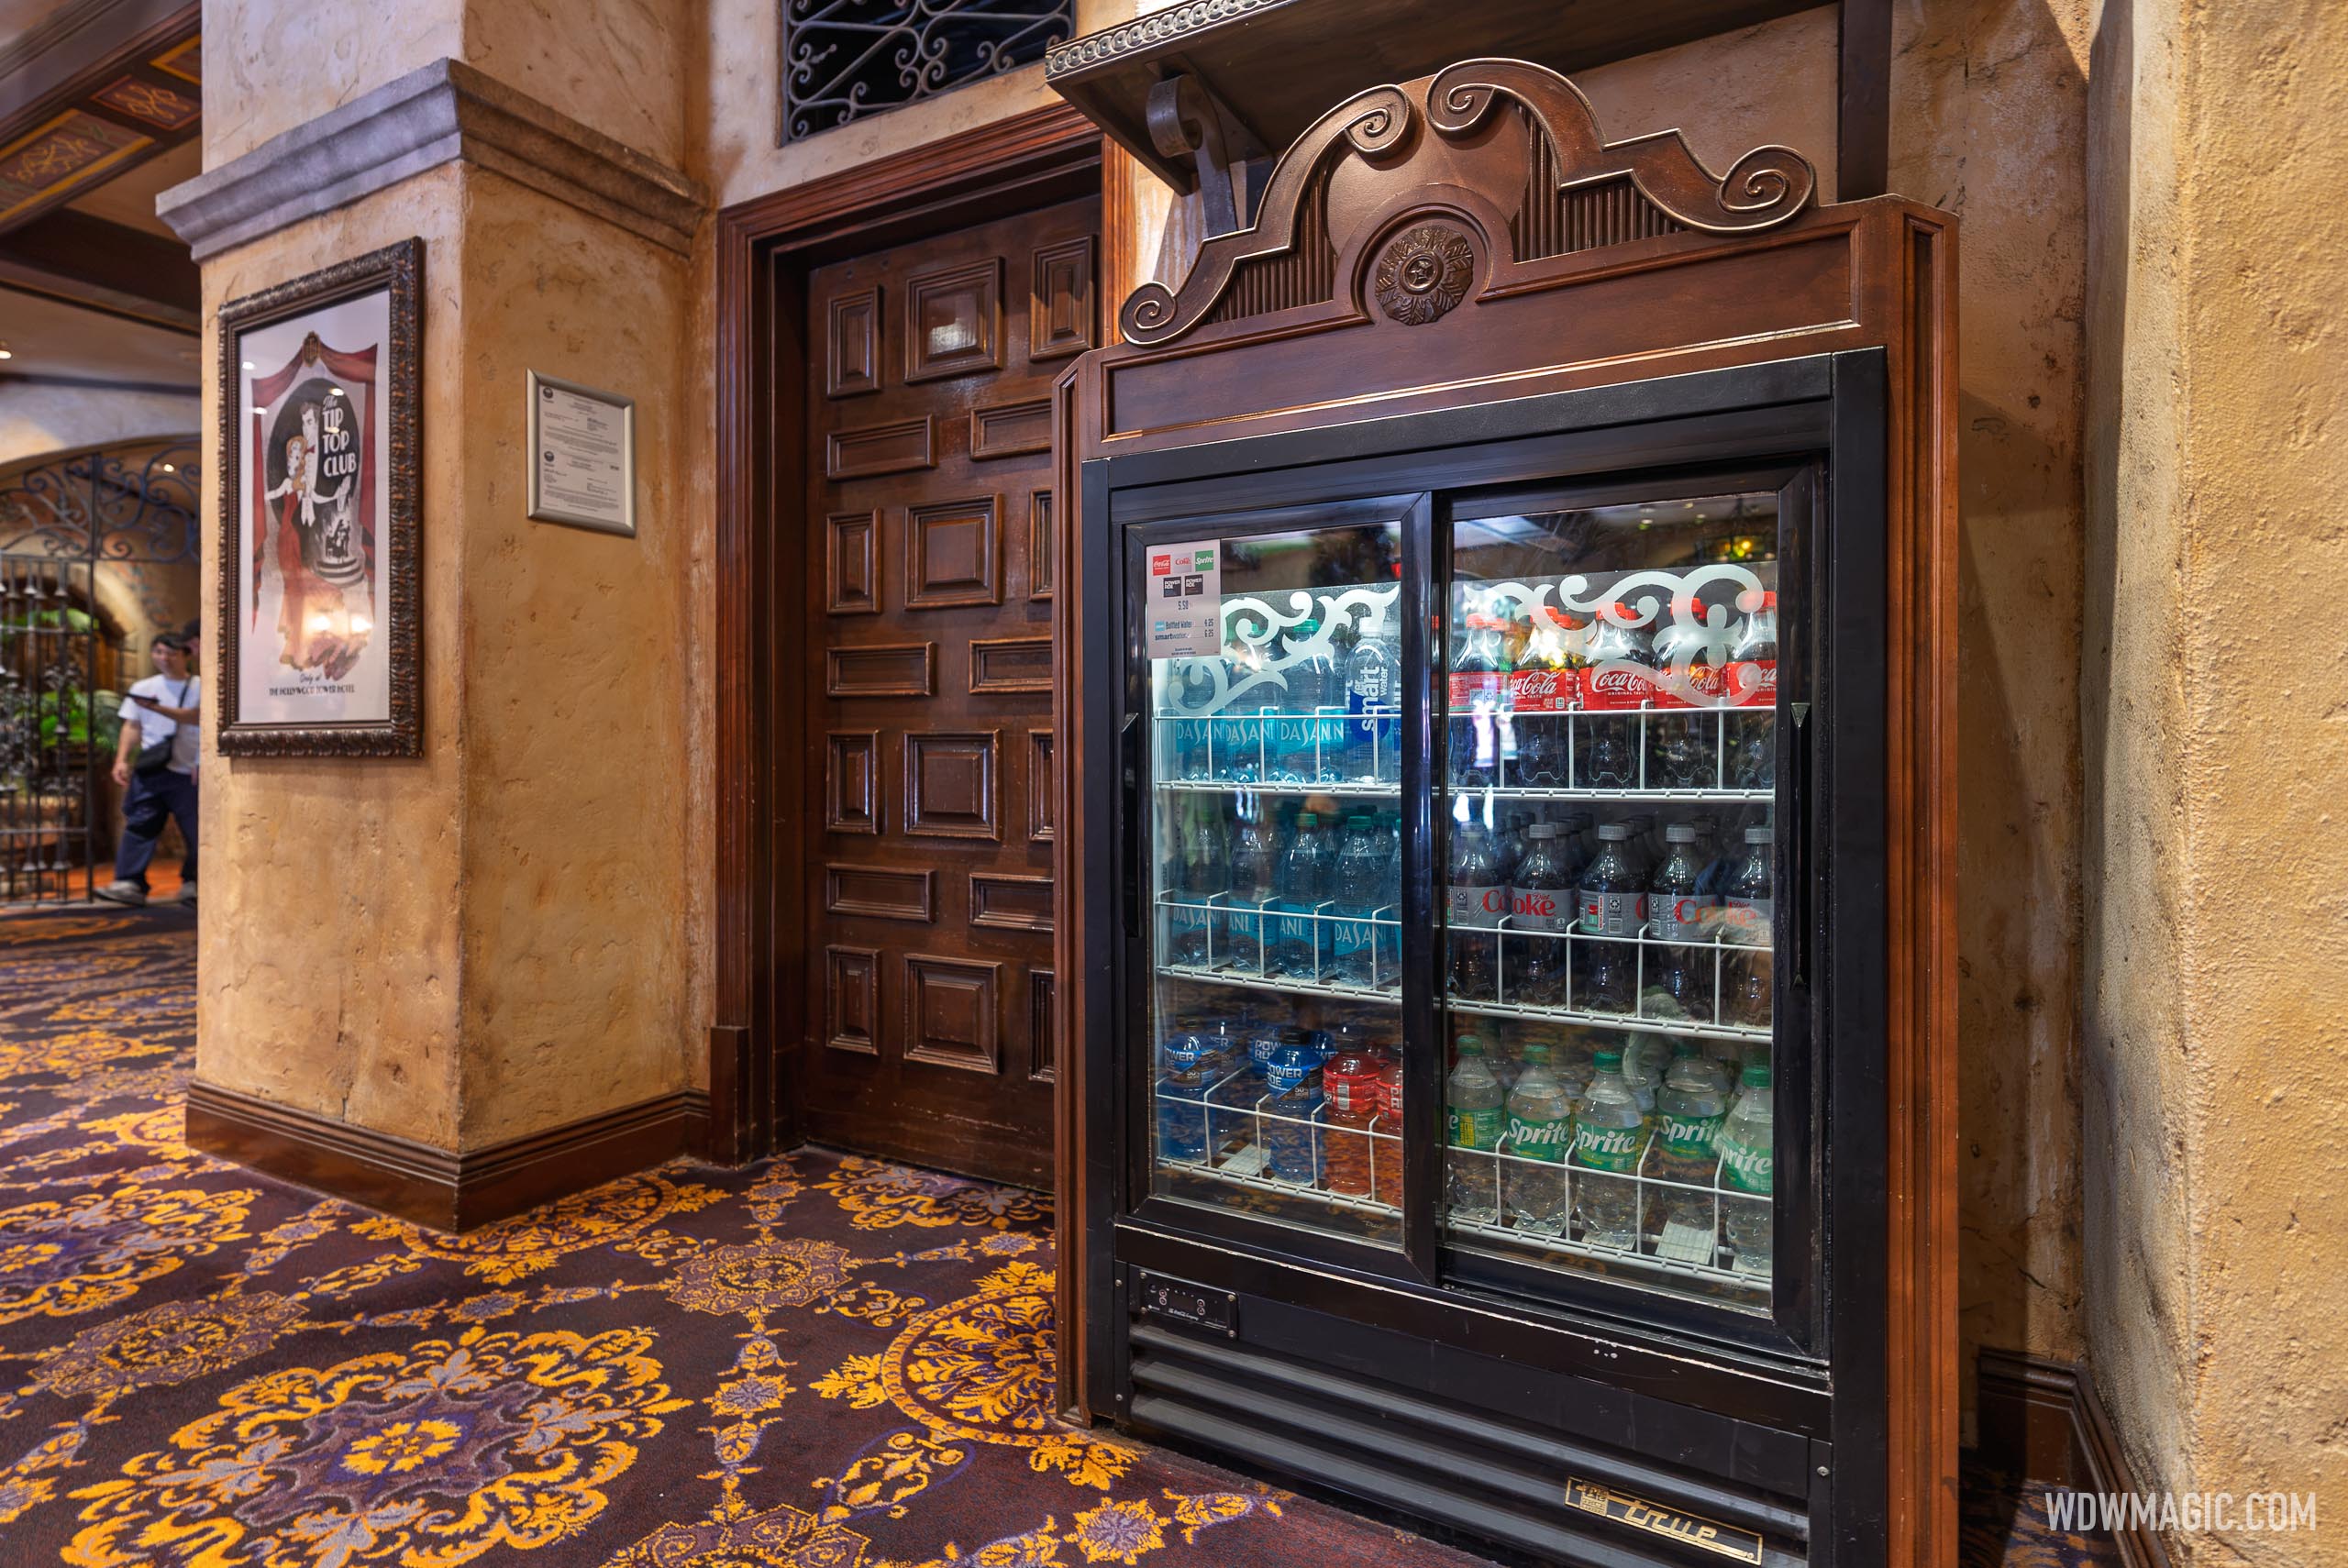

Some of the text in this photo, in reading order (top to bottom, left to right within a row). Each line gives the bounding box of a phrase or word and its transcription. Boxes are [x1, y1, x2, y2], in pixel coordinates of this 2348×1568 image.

[322, 408, 343, 429] TIP
[323, 430, 349, 454] TOP
[323, 453, 357, 478] CLUB
[1196, 557, 1214, 565] Sprite
[270, 688, 278, 696] THE
[338, 683, 355, 693] HOTEL
[1379, 667, 1389, 697] water
[1361, 667, 1379, 732] smart
[1335, 922, 1387, 949] DASANI
[1509, 1119, 1569, 1145] Sprite
[1576, 1123, 1636, 1154] Sprite
[1624, 1500, 1718, 1542] true
